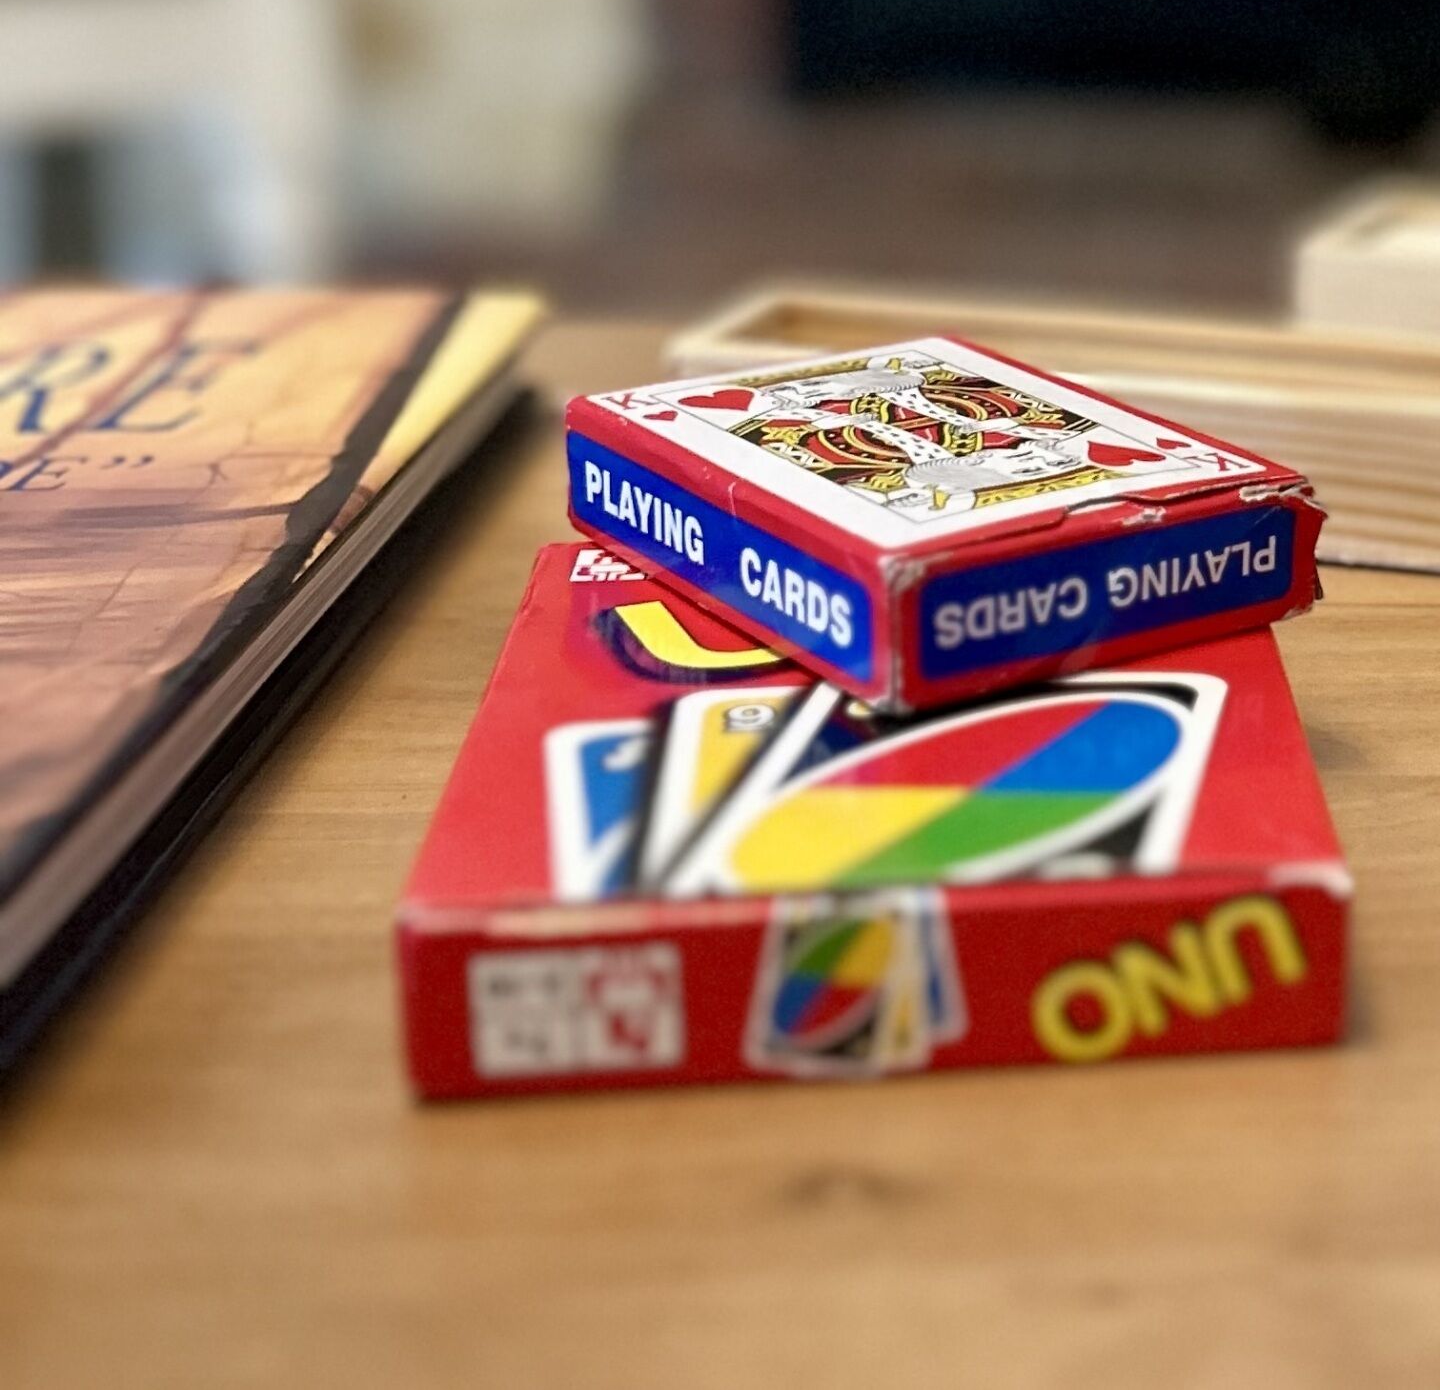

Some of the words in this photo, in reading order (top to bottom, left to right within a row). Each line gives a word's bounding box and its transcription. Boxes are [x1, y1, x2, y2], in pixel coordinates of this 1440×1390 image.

[585, 461, 704, 566] PLAYING
[740, 547, 852, 647] CARDS
[933, 577, 1088, 650] CARDS
[1108, 535, 1276, 607] PLAYING
[1032, 894, 1305, 1064] UNO
